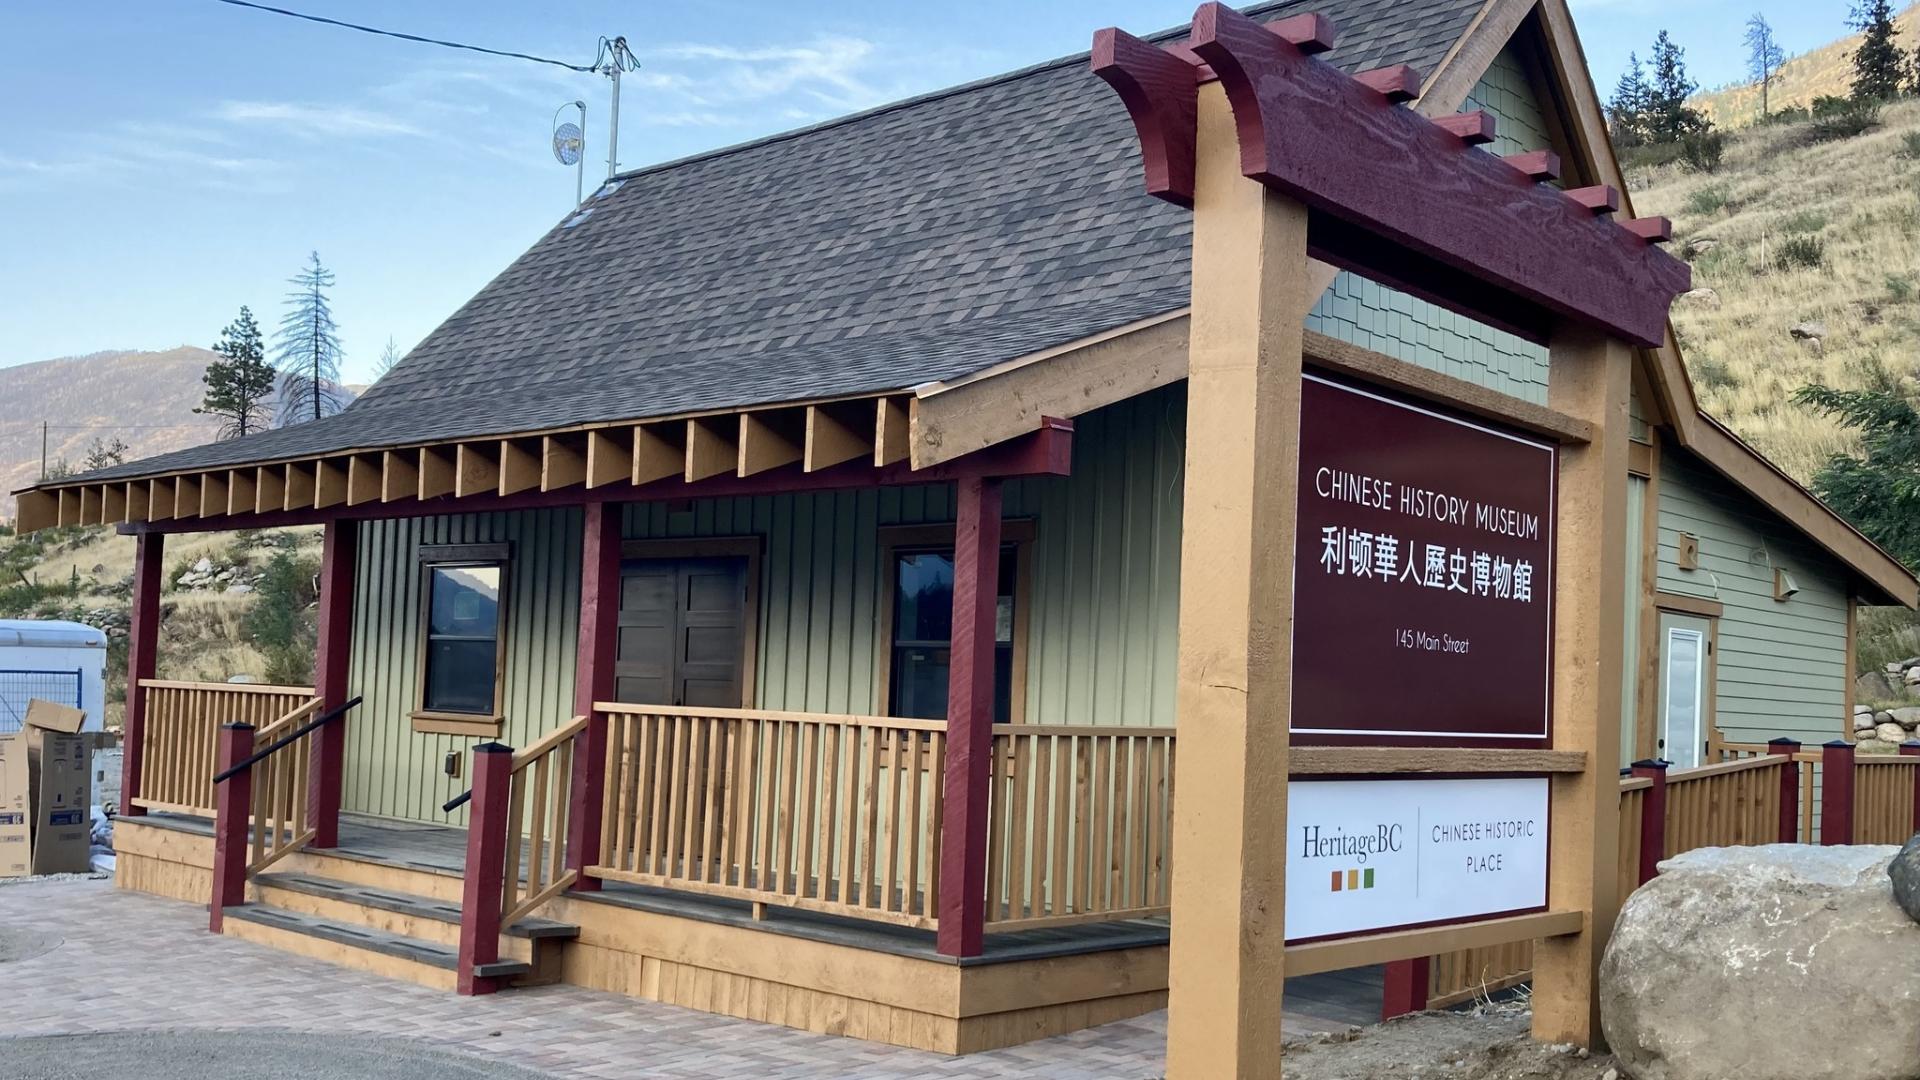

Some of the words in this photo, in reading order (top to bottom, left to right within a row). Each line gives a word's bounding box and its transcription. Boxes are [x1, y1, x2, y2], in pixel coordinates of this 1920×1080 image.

[1316, 467, 1392, 511] CHINESE
[1400, 485, 1469, 526] HISTORY
[1475, 502, 1538, 540] MUSEUM
[1396, 629, 1413, 649] 145
[1416, 631, 1440, 652] Main
[1443, 633, 1470, 654] Street
[1302, 823, 1403, 864] HeritageBC
[1432, 823, 1481, 843] CHINESE
[1485, 820, 1535, 840] HISTORIC
[1466, 854, 1502, 873] PLACE
